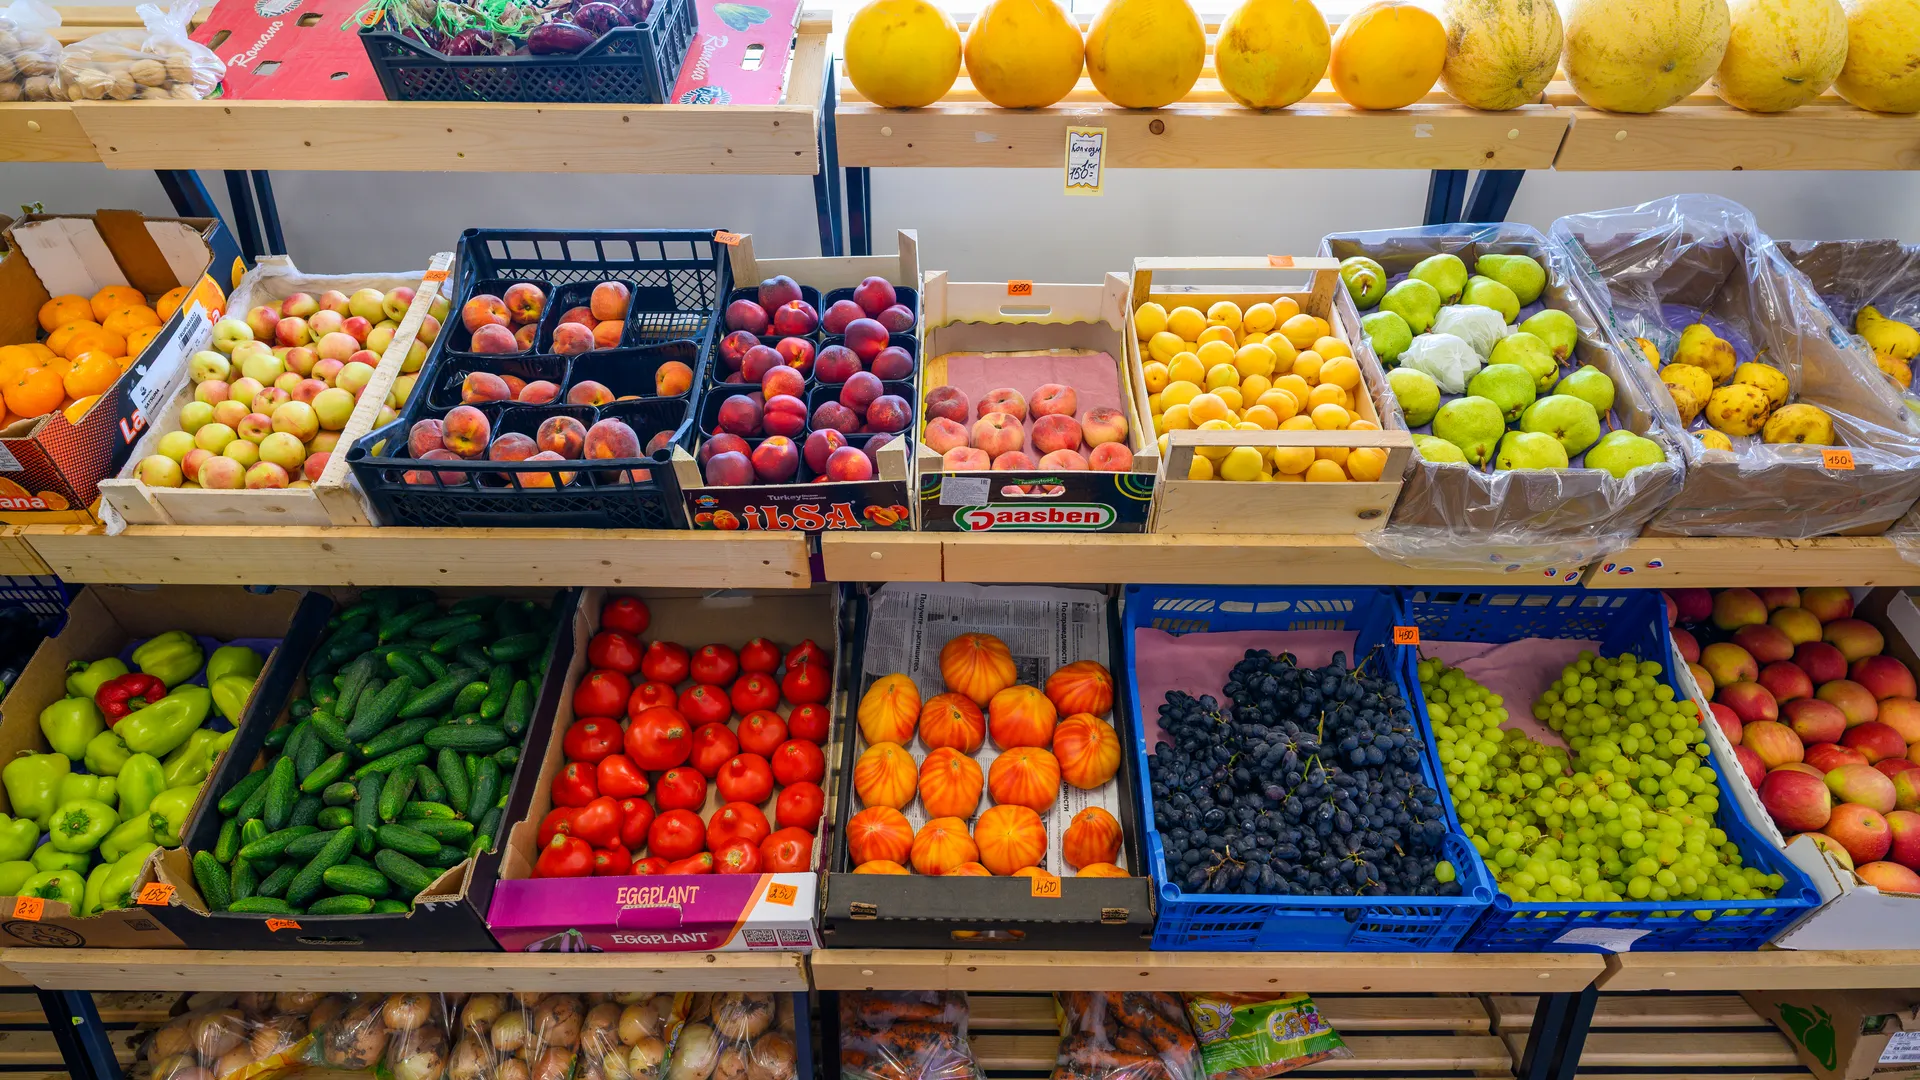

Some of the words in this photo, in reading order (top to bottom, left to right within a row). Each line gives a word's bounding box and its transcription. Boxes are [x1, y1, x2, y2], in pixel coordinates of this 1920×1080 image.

[227, 20, 284, 68] Romano
[690, 34, 729, 80] Romano
[1011, 283, 1030, 292] 550
[767, 493, 802, 501] Turkey
[1035, 880, 1057, 893] 450
[144, 888, 167, 901] 150
[615, 885, 700, 905] EGGPLANT
[610, 932, 708, 944] EGGPLANT
